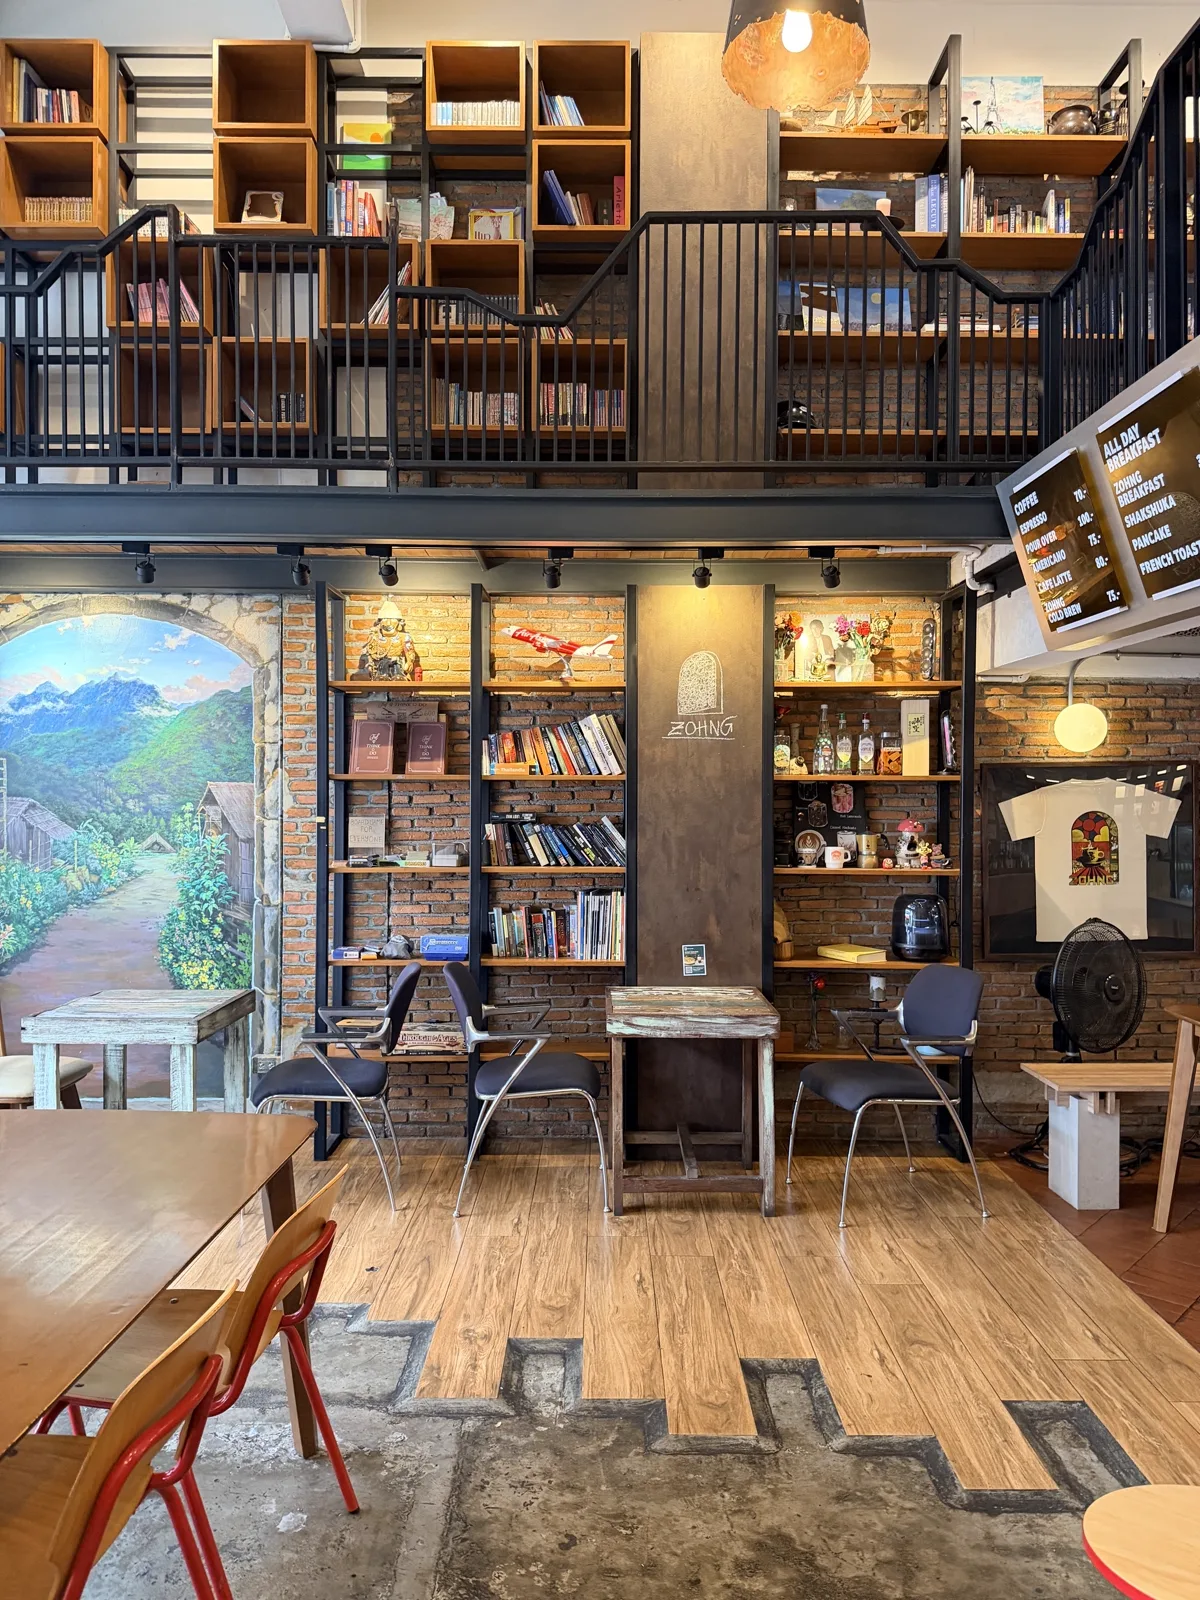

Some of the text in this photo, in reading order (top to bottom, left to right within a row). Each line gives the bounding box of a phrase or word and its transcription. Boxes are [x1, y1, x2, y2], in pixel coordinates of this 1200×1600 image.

[1104, 422, 1140, 459] ALL DAY
[1106, 428, 1161, 473] BREAKFAST
[1114, 470, 1142, 495] ZOHNG
[1117, 473, 1165, 508] BREAKFAST
[1014, 490, 1039, 516] COFFEE
[1124, 494, 1176, 528] SHAKSHUKA
[1020, 510, 1048, 536] ESPRESSO
[1025, 538, 1042, 555] POUR
[1040, 530, 1058, 547] OVER
[1132, 524, 1172, 552] PANCAKE
[1032, 549, 1066, 574] AMERICANO
[1140, 552, 1174, 576] FRENCH
[1053, 570, 1073, 588] LATTE
[1044, 597, 1066, 613] ZOHNG
[1048, 609, 1064, 624] COLD
[1063, 602, 1082, 618] BREW
[667, 715, 738, 736] ZOHNG
[350, 834, 383, 842] EVERYONE
